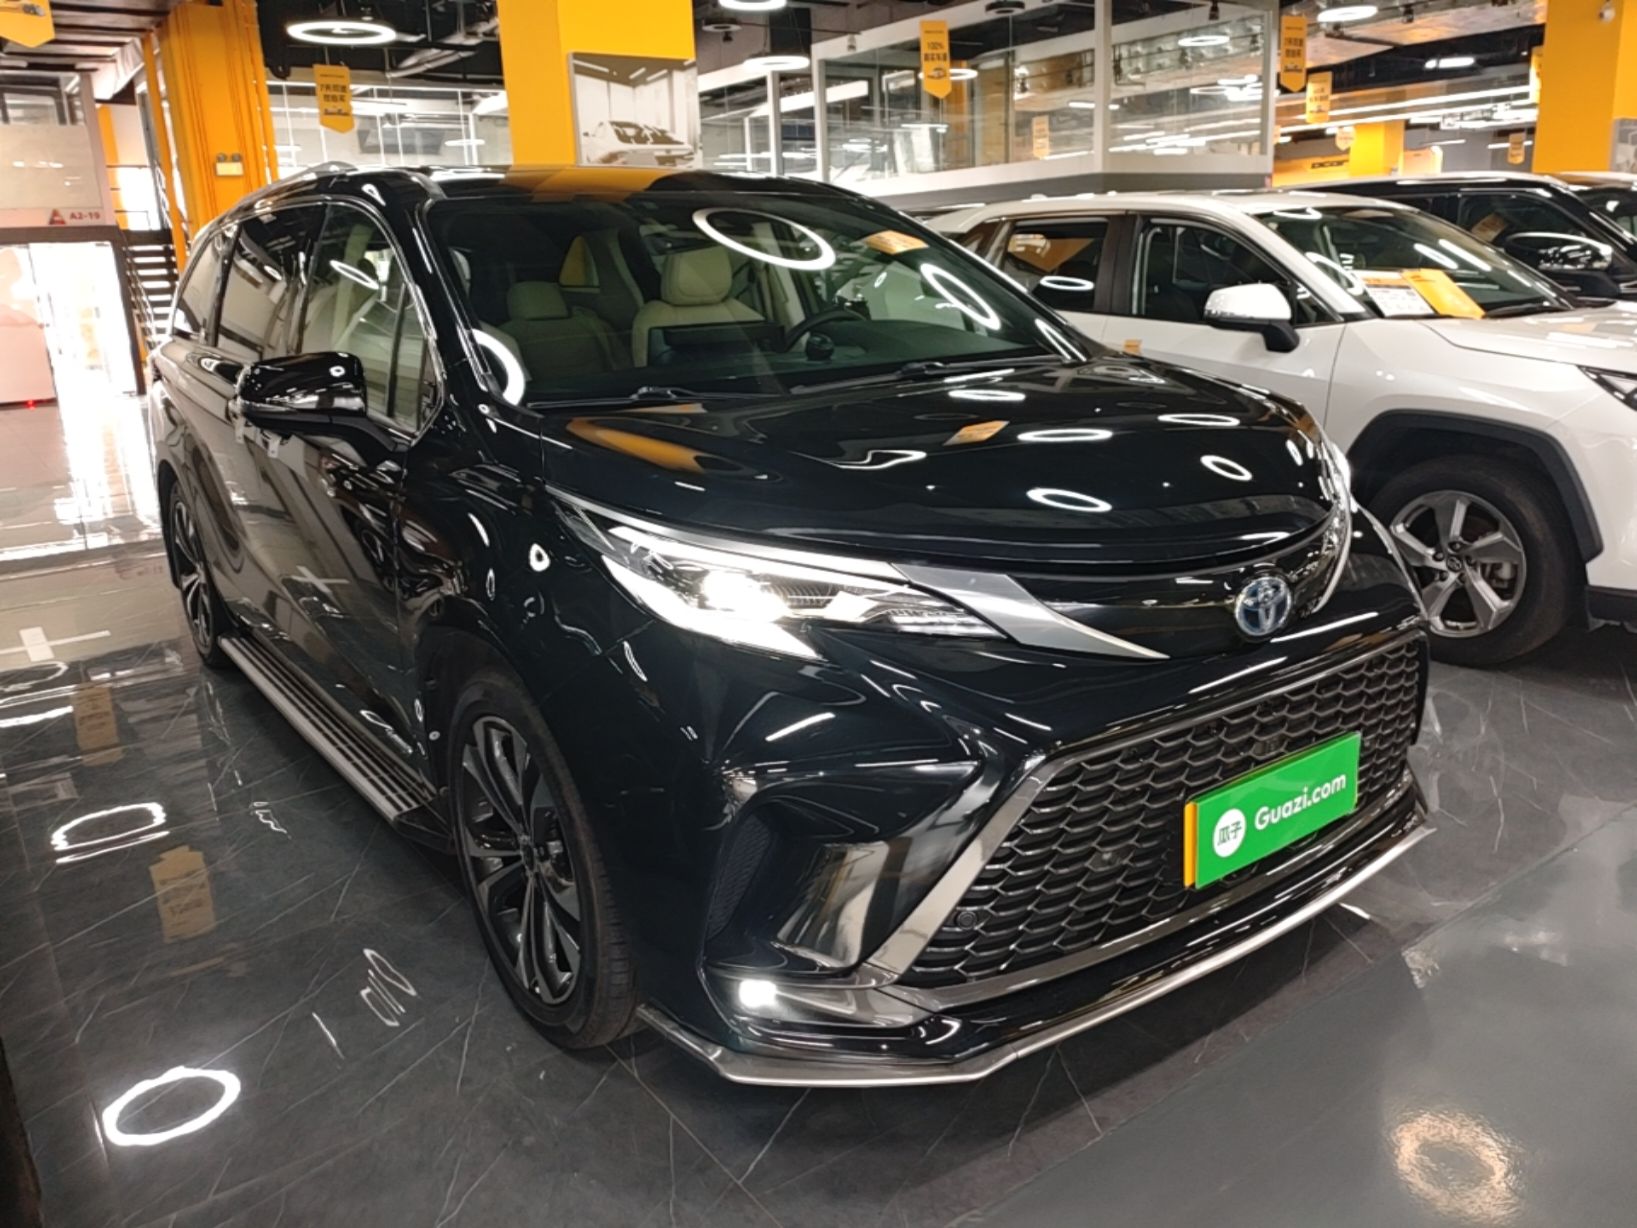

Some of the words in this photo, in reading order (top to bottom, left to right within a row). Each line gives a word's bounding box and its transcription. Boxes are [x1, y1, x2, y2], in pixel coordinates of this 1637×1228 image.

[69, 212, 100, 220] A2-19
[1254, 774, 1347, 831] Guazi.com
[1217, 820, 1242, 846] 瓜子
